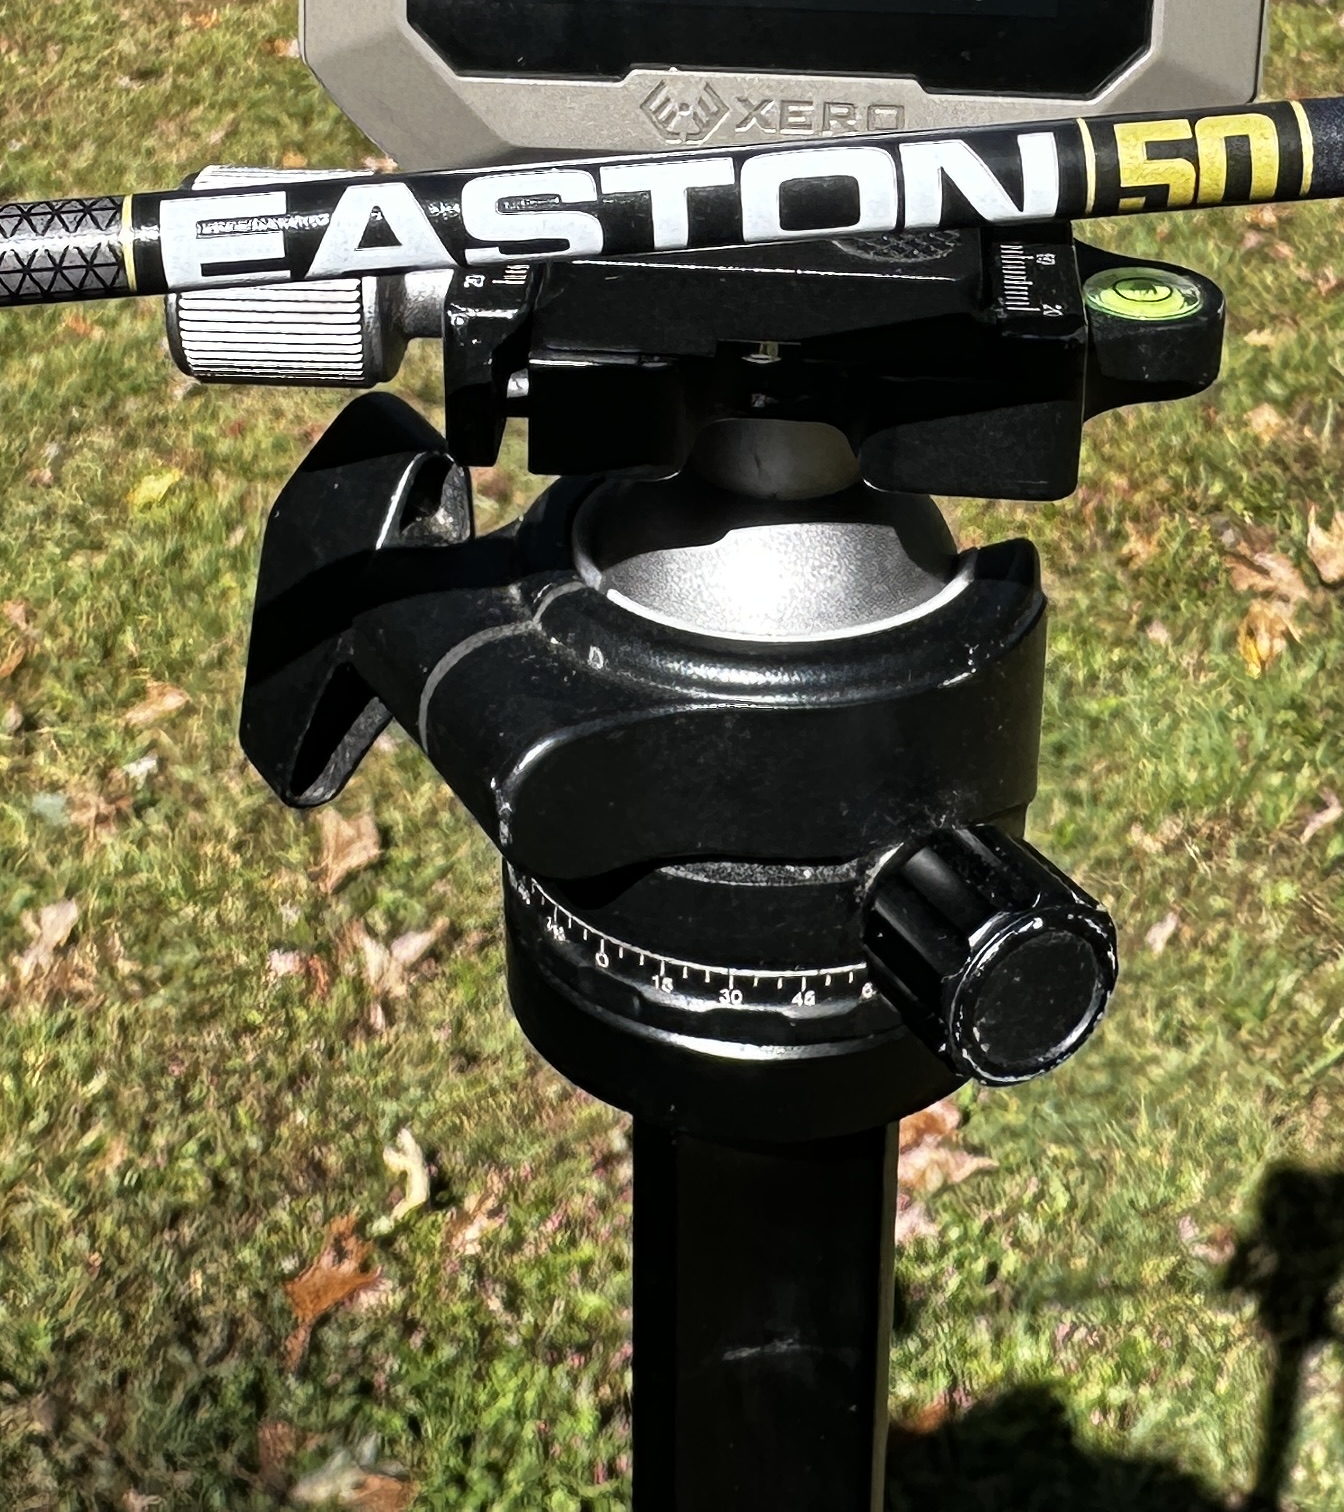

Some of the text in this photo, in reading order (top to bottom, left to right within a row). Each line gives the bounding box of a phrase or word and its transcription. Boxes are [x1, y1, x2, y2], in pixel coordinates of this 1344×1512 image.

[735, 97, 905, 136] XERO
[159, 131, 1057, 289] EASTON
[718, 988, 743, 1006] 30
